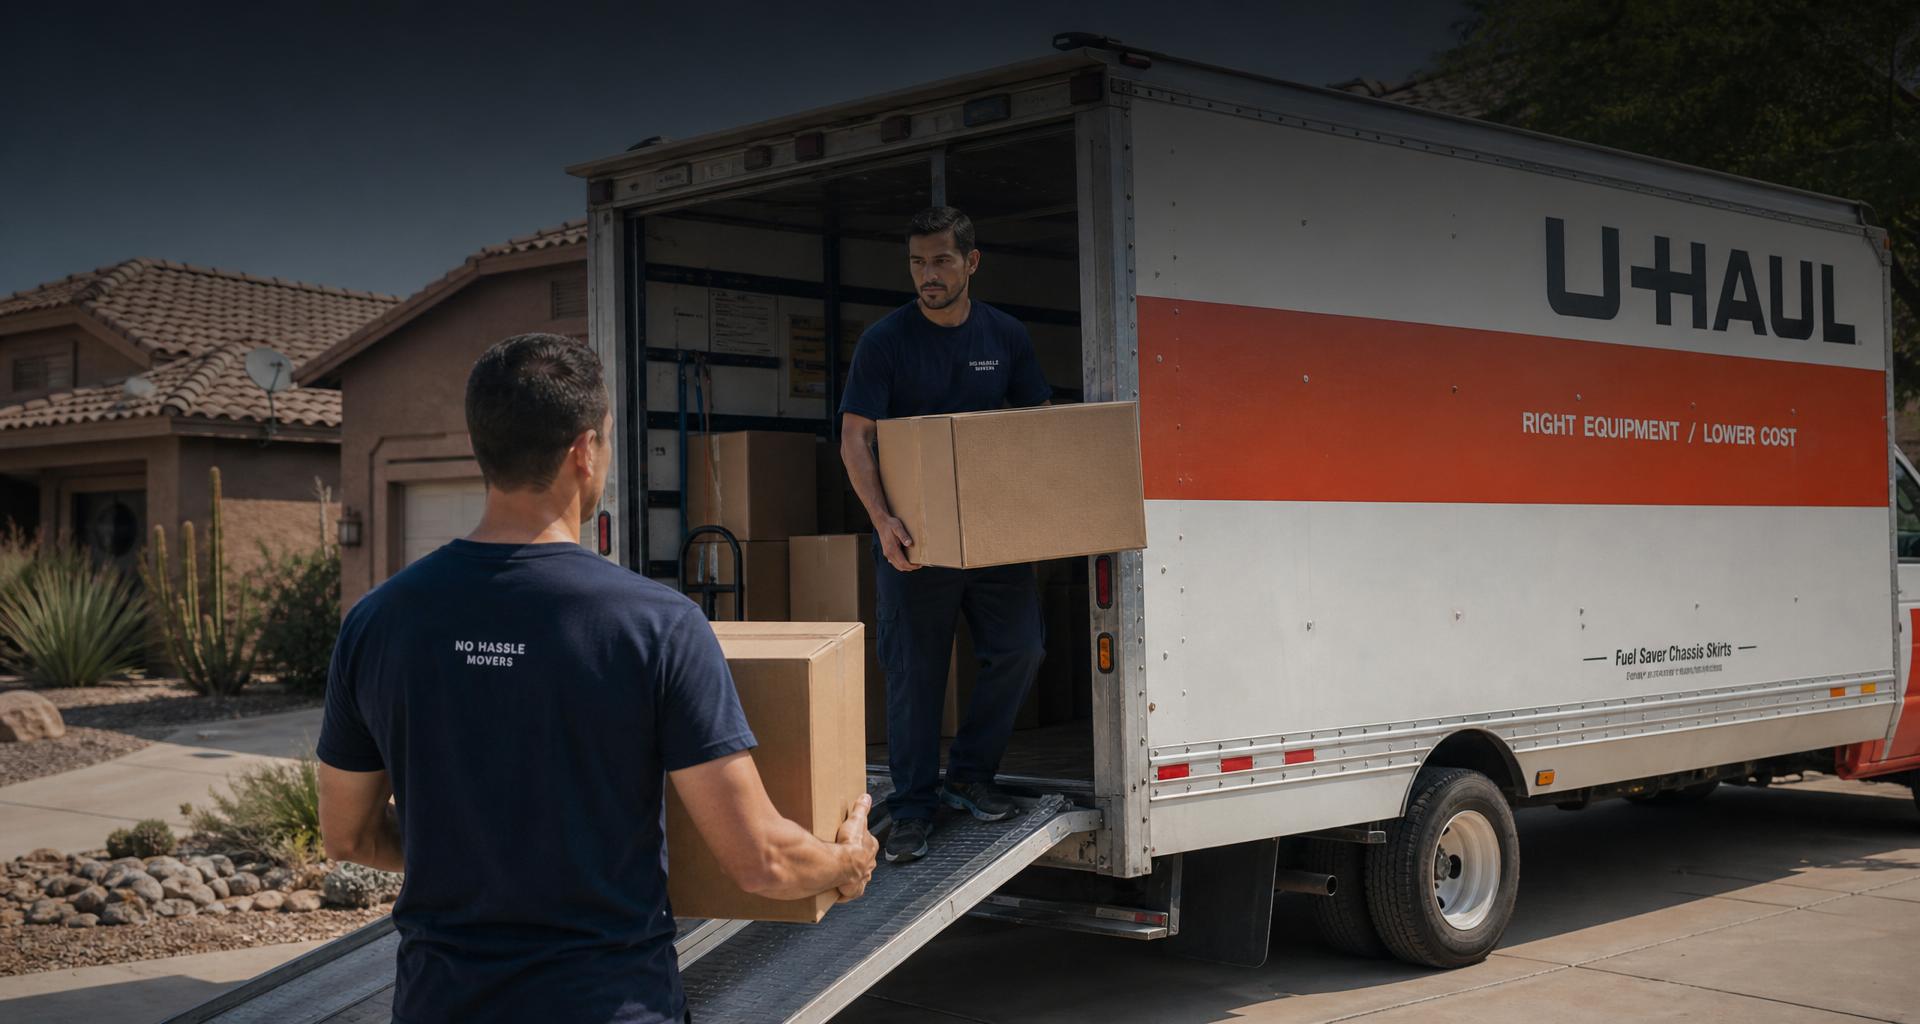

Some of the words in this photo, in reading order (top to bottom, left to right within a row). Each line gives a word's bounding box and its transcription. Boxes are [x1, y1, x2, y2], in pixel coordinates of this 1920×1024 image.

[1522, 411, 1576, 437] RIGHT
[1584, 415, 1680, 442] EQUIPMENT
[1688, 422, 1697, 443] /
[1703, 423, 1756, 445] LOWER
[1760, 426, 1797, 447] COST
[455, 640, 474, 652] NO
[478, 641, 526, 655] HASSLE
[1616, 648, 1637, 666] Fuel
[1640, 647, 1666, 664] Saver
[1669, 644, 1704, 662] Chassis
[1707, 642, 1732, 658] Skirts
[466, 654, 513, 667] MOVERS
